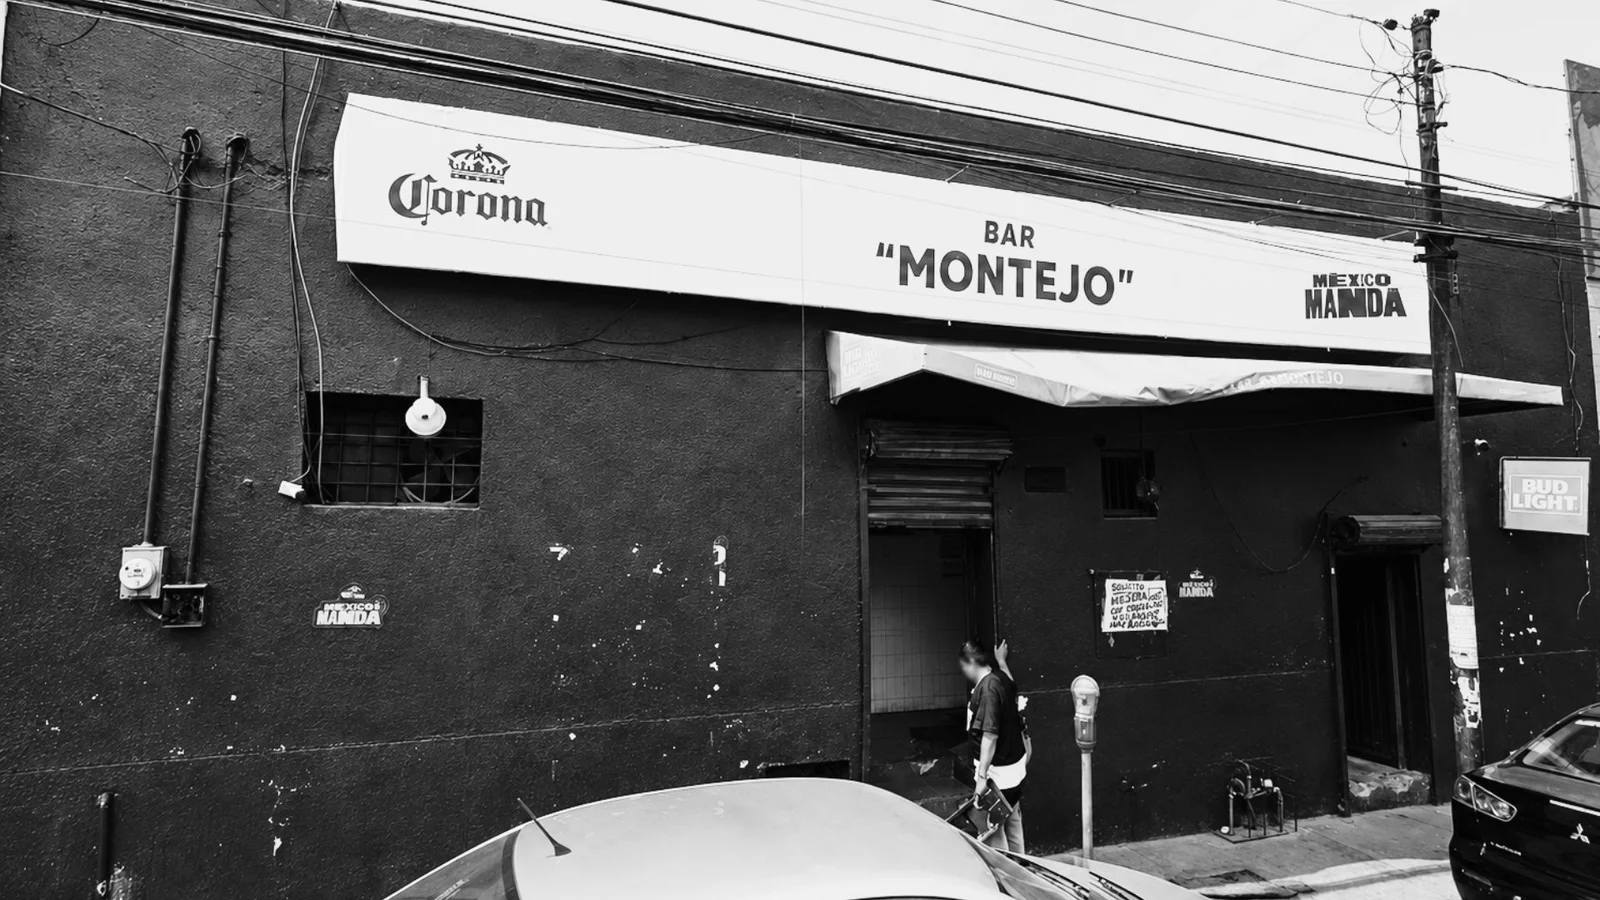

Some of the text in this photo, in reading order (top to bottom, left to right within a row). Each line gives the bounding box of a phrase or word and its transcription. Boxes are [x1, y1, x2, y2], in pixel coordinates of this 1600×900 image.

[388, 173, 548, 226] Corona
[984, 220, 1035, 248] BAR
[876, 242, 1134, 306] "MONTEJO"
[1305, 287, 1407, 319] MANDA
[1522, 478, 1569, 495] BUD
[316, 610, 381, 625] MANDA
